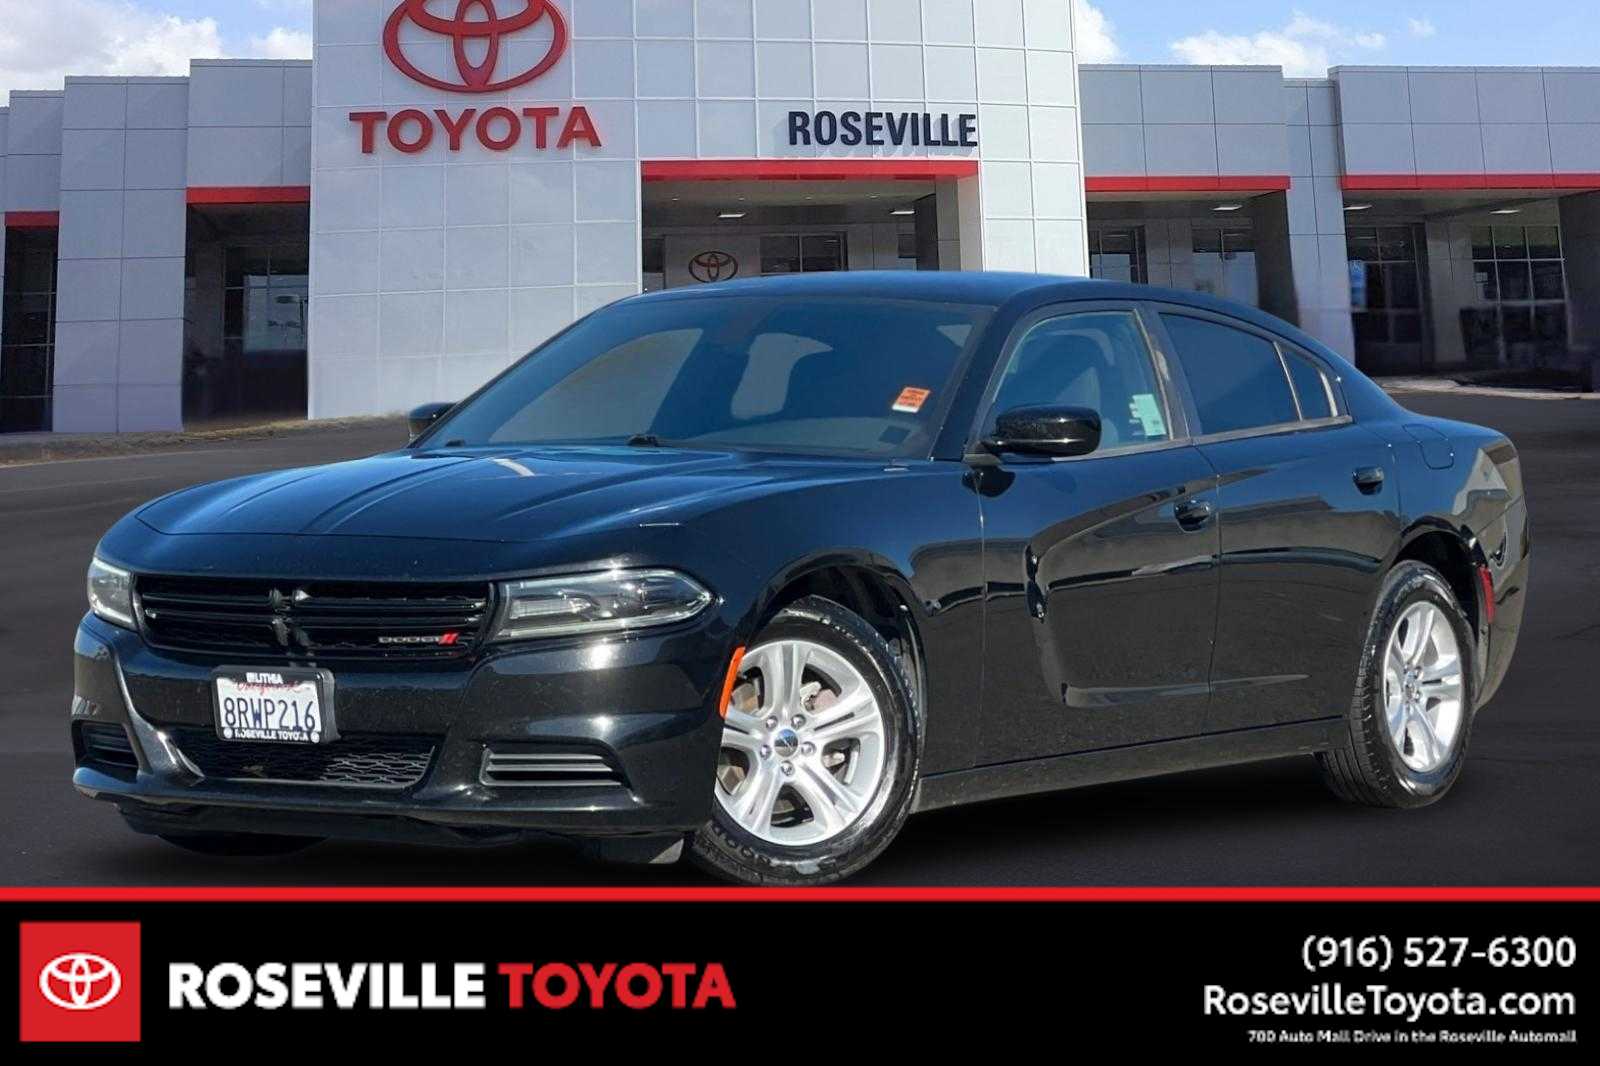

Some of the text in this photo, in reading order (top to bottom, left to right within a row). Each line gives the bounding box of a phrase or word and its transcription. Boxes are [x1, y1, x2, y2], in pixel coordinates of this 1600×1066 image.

[349, 106, 602, 153] TOYOTA
[788, 110, 978, 147] ROSEVILLE
[223, 697, 316, 732] 8RWP216
